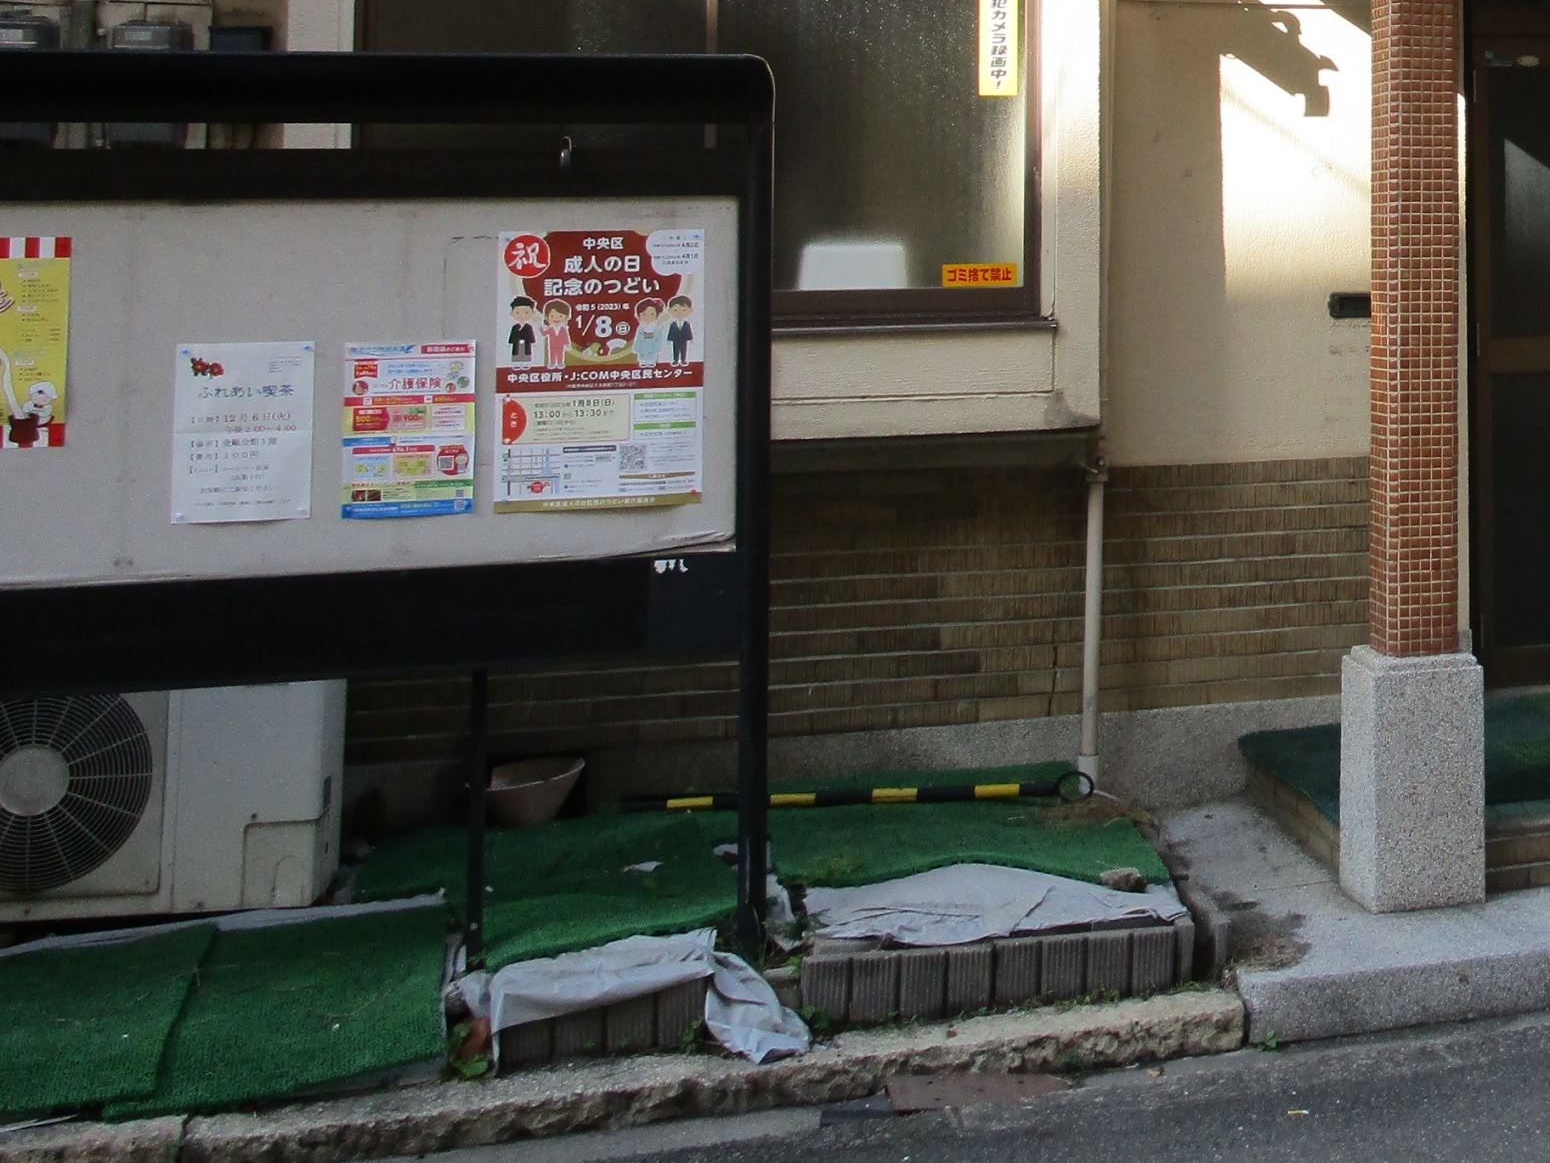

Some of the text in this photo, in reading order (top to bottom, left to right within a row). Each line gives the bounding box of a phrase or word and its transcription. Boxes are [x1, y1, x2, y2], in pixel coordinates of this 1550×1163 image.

[582, 236, 625, 250] 中央区
[507, 242, 547, 270] 祝
[563, 254, 641, 274] 成人の日
[946, 267, 1012, 283] ゴミ捨て禁止
[543, 277, 661, 297] 記念のつどい
[197, 383, 295, 399] ふれあい喫茶
[388, 377, 443, 390] 介護保険
